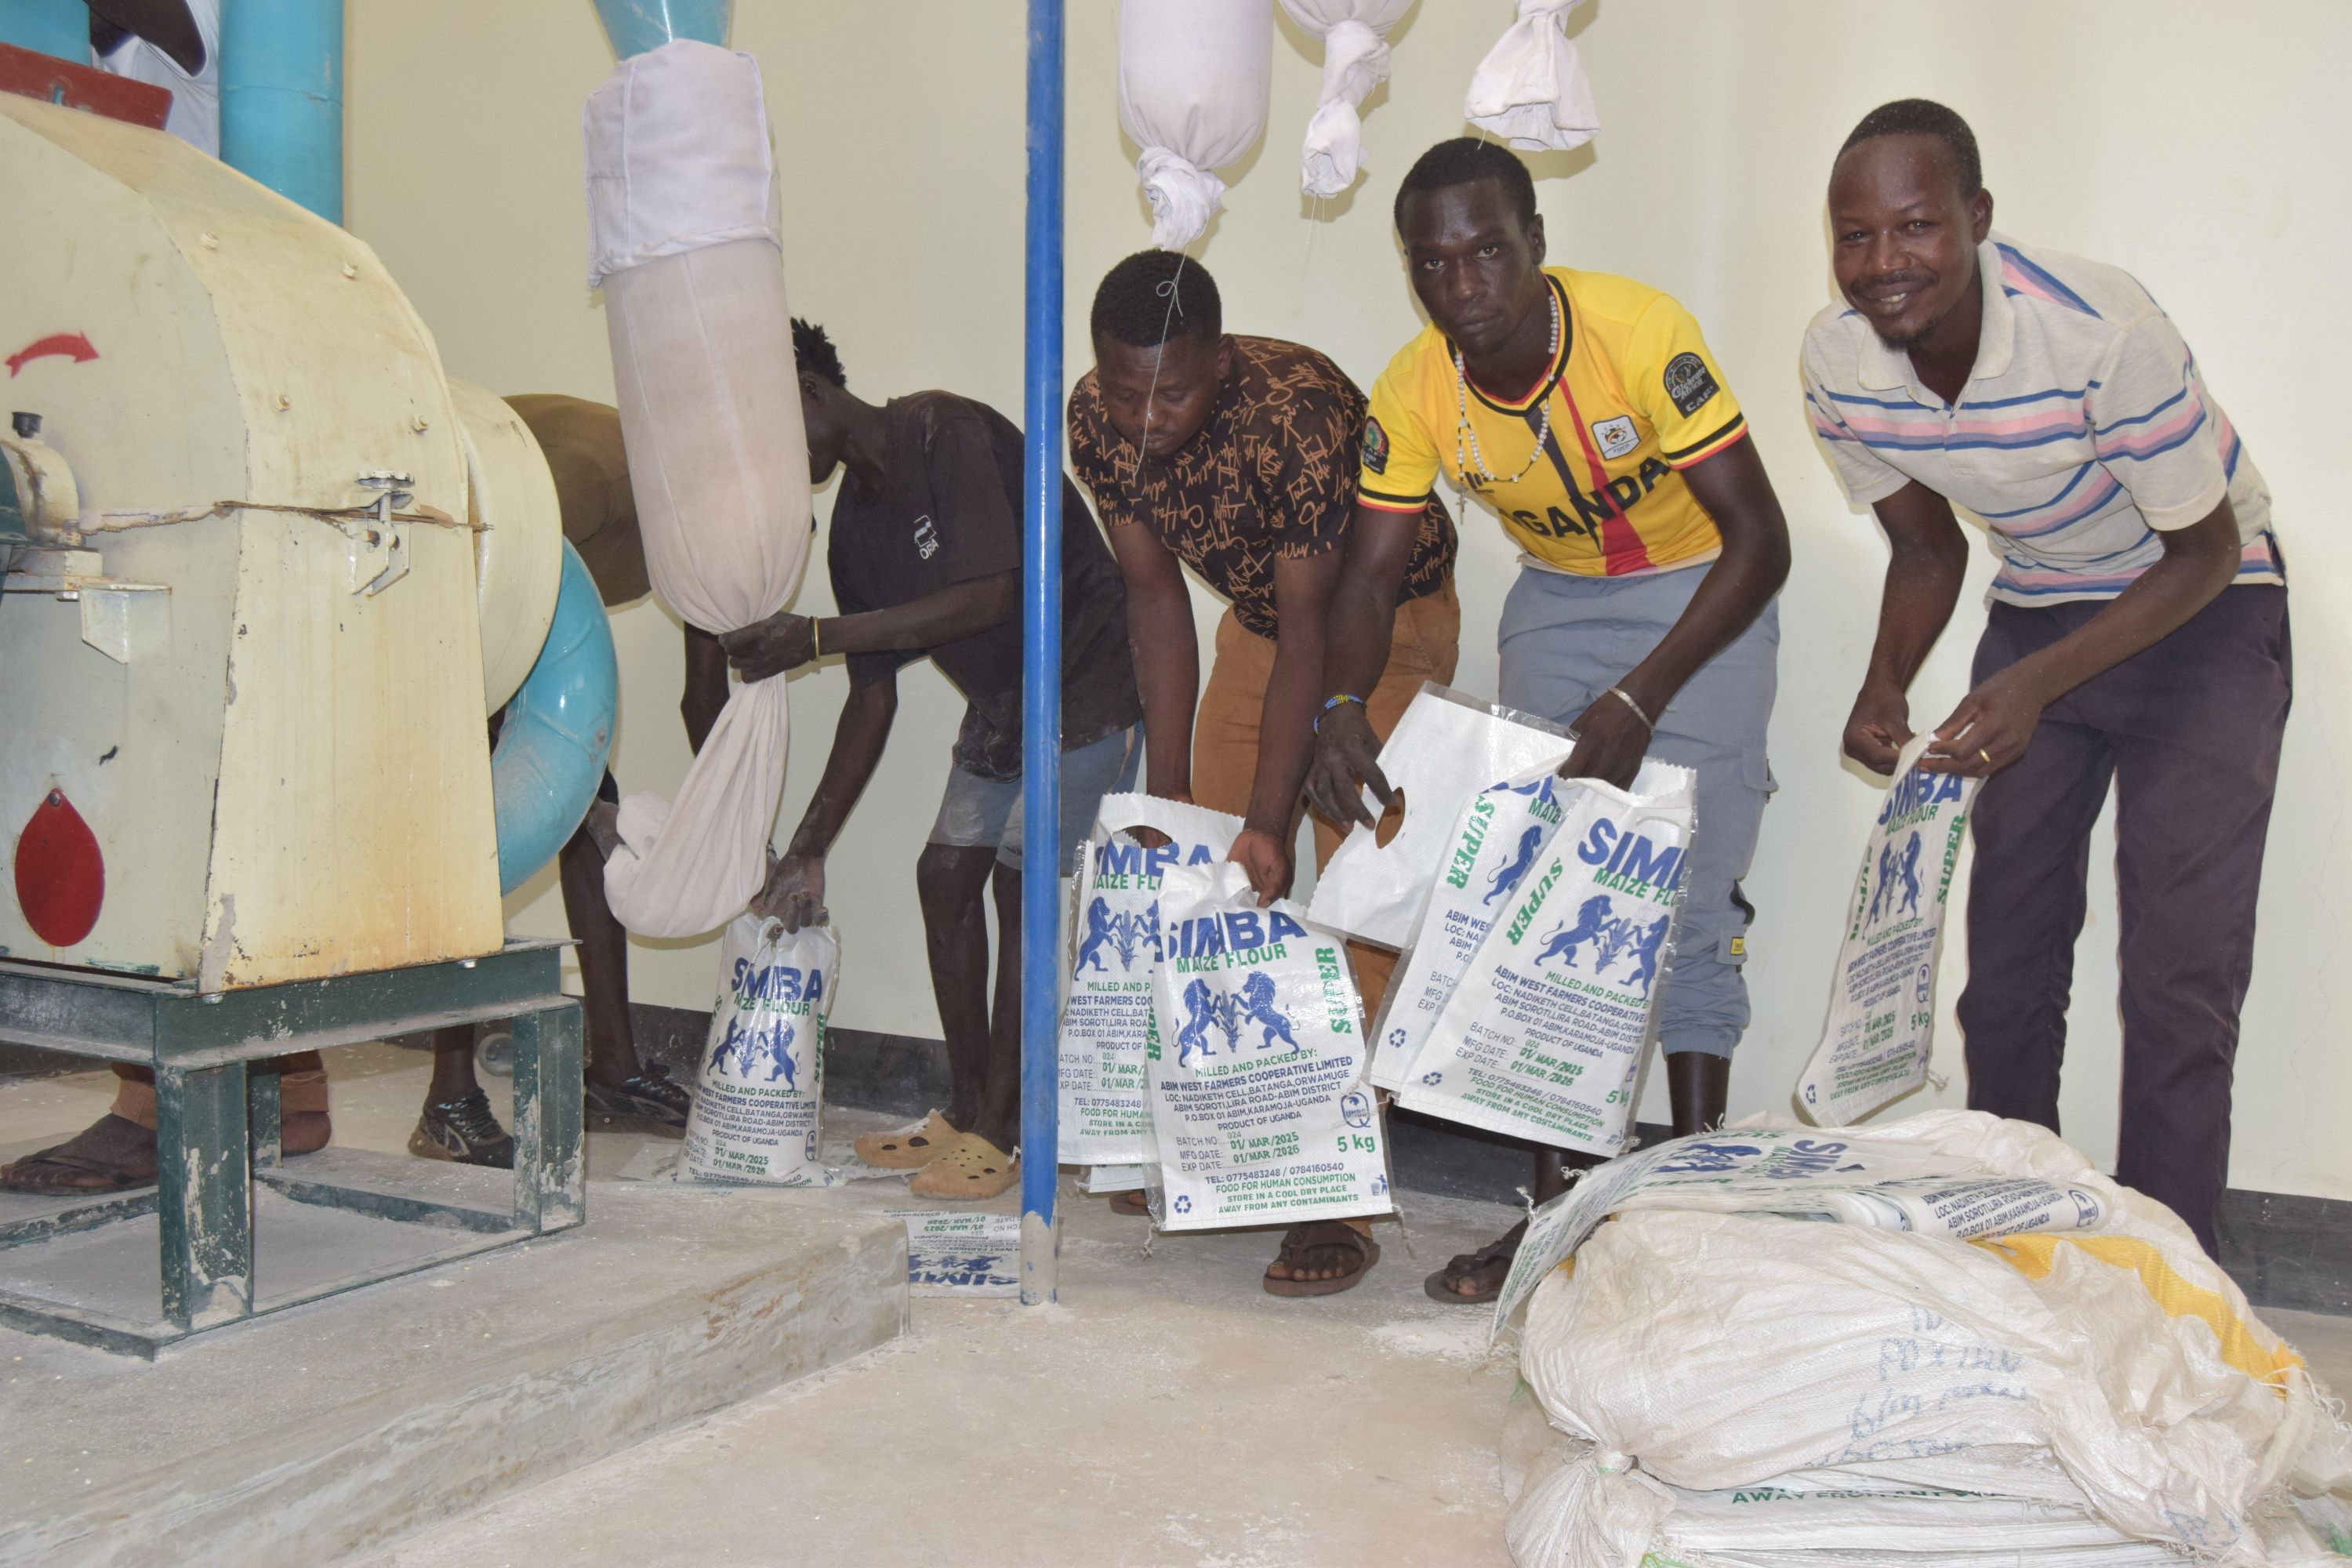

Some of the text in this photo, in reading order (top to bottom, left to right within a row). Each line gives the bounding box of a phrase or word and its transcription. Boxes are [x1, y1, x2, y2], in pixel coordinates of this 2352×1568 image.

[1686, 386, 1712, 412] CAF
[1497, 456, 1671, 538] GANDA
[1446, 795, 1495, 889] SUPER
[1592, 867, 1652, 898] MAIZE
[1506, 857, 1563, 946] SUPER
[1446, 909, 1469, 925] ABIM
[1445, 923, 1465, 937] LOC:
[1450, 937, 1472, 950] ABIM
[1177, 943, 1287, 973] MAIZE FLOUR
[731, 957, 822, 1002] SMBA
[1087, 982, 1142, 991] MILLED AND
[1545, 971, 1642, 1008] MILLED AND PACKED
[1315, 947, 1352, 1033] SUPER
[1424, 986, 1443, 1000] MFG
[1491, 978, 1557, 1008] LOC: NADIKETH
[1494, 964, 1646, 1023] ABIM WEST FARMERS COOPERATIVE
[763, 999, 810, 1015] FLOUR
[1071, 996, 1133, 1005] WEST FARMERS
[1417, 999, 1435, 1011] EXP
[1495, 993, 1621, 1037] ABIM ROAD-ABIM
[1911, 1011, 1929, 1030] 5 kg
[1470, 1022, 1500, 1042] BATCH
[1462, 1036, 1482, 1050] MFG
[1525, 1028, 1603, 1058] PRODUCT OF UGANDA
[1196, 1048, 1317, 1077] MILLED AND PACKED BY:
[1455, 1047, 1474, 1060] EXP
[1161, 1056, 1352, 1091] ABIM WEST FARMERS COOPERATIVE LIMITED
[702, 1086, 714, 1097] WEST
[716, 1092, 746, 1105] FARMERS
[749, 1100, 799, 1109] COOPERATIVE
[713, 1080, 735, 1093] MILLED
[759, 1089, 793, 1098] PACKED
[1174, 1081, 1341, 1112] ABIM ROAD-ABIM DISTRICT
[1183, 1091, 1224, 1102] NADIKETH
[1468, 1068, 1602, 1116] TEL: 0775483248 0784160540
[1606, 1091, 1619, 1104] 5
[1092, 1098, 1142, 1107] 0775483248
[1471, 1076, 1605, 1127] FOOD FOR HUMAN CONSUMPTION
[1475, 1087, 1589, 1131] STORE IN COOL DRY PLACE
[742, 1117, 783, 1127] ROAD-ABIM
[1185, 1113, 1214, 1123] P.O.BOX
[1218, 1111, 1301, 1131] PRODUCT OF UGANDA
[1461, 1093, 1484, 1106] AWAY
[1486, 1101, 1509, 1114] FROM
[1530, 1115, 1593, 1142] CONTAMINANTS
[713, 1130, 741, 1142] PRODUCT
[753, 1138, 779, 1146] UGANDA
[1177, 1137, 1203, 1146] BATCH
[1180, 1135, 1270, 1160] MFG MAR
[1337, 1134, 1376, 1153] 5 kg
[689, 1167, 702, 1176] TEL:
[1181, 1162, 1197, 1172] EXP
[1205, 1163, 1344, 1184] TEL: 0775483248 0784160540
[1216, 1172, 1356, 1193] FOOD FOR HUMAN CONSUMPTION
[1218, 1194, 1359, 1214] AWAY FROM ANY CONTAMINANTS
[1227, 1193, 1254, 1203] STORE
[1277, 1189, 1298, 1198] COOL
[1301, 1187, 1317, 1196] DRY
[1320, 1185, 1348, 1193] PLACE
[1934, 1194, 1981, 1219] LOC: NADIKETH
[1948, 1215, 1966, 1230] ABIM
[1985, 1221, 1993, 1231] 01
[2014, 1213, 2050, 1236] OF UGANDA
